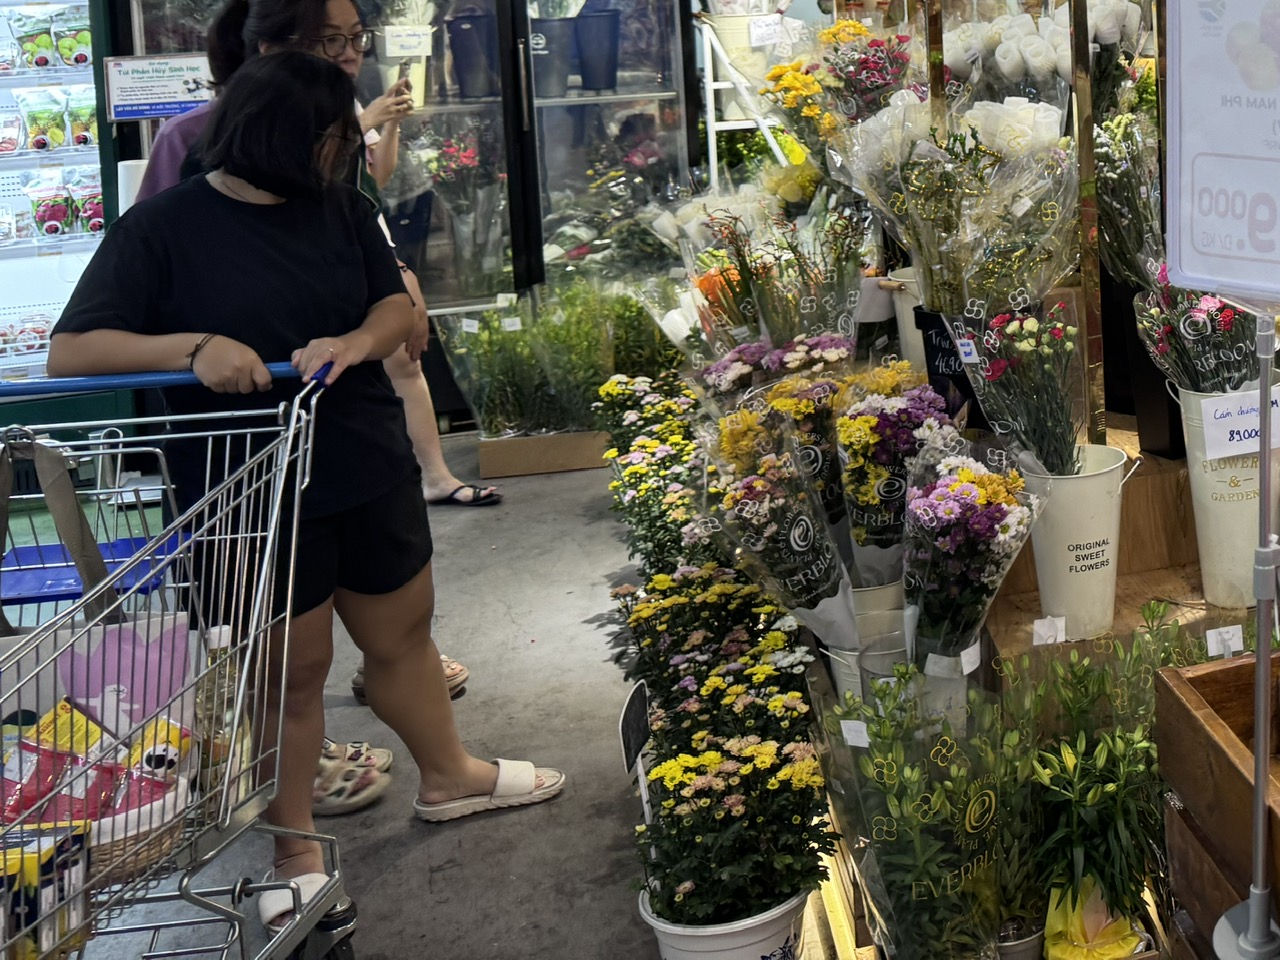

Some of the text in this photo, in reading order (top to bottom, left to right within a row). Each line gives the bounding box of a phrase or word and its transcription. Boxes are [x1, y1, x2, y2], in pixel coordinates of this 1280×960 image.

[1201, 456, 1260, 474] FLOWER
[1228, 475, 1242, 488] &
[1210, 488, 1260, 502] GARDEN
[1067, 537, 1111, 552] ORIGINAL
[1074, 549, 1106, 562] SWEET
[1068, 558, 1110, 574] FLOWERS
[912, 837, 1001, 901] EVERBLO
